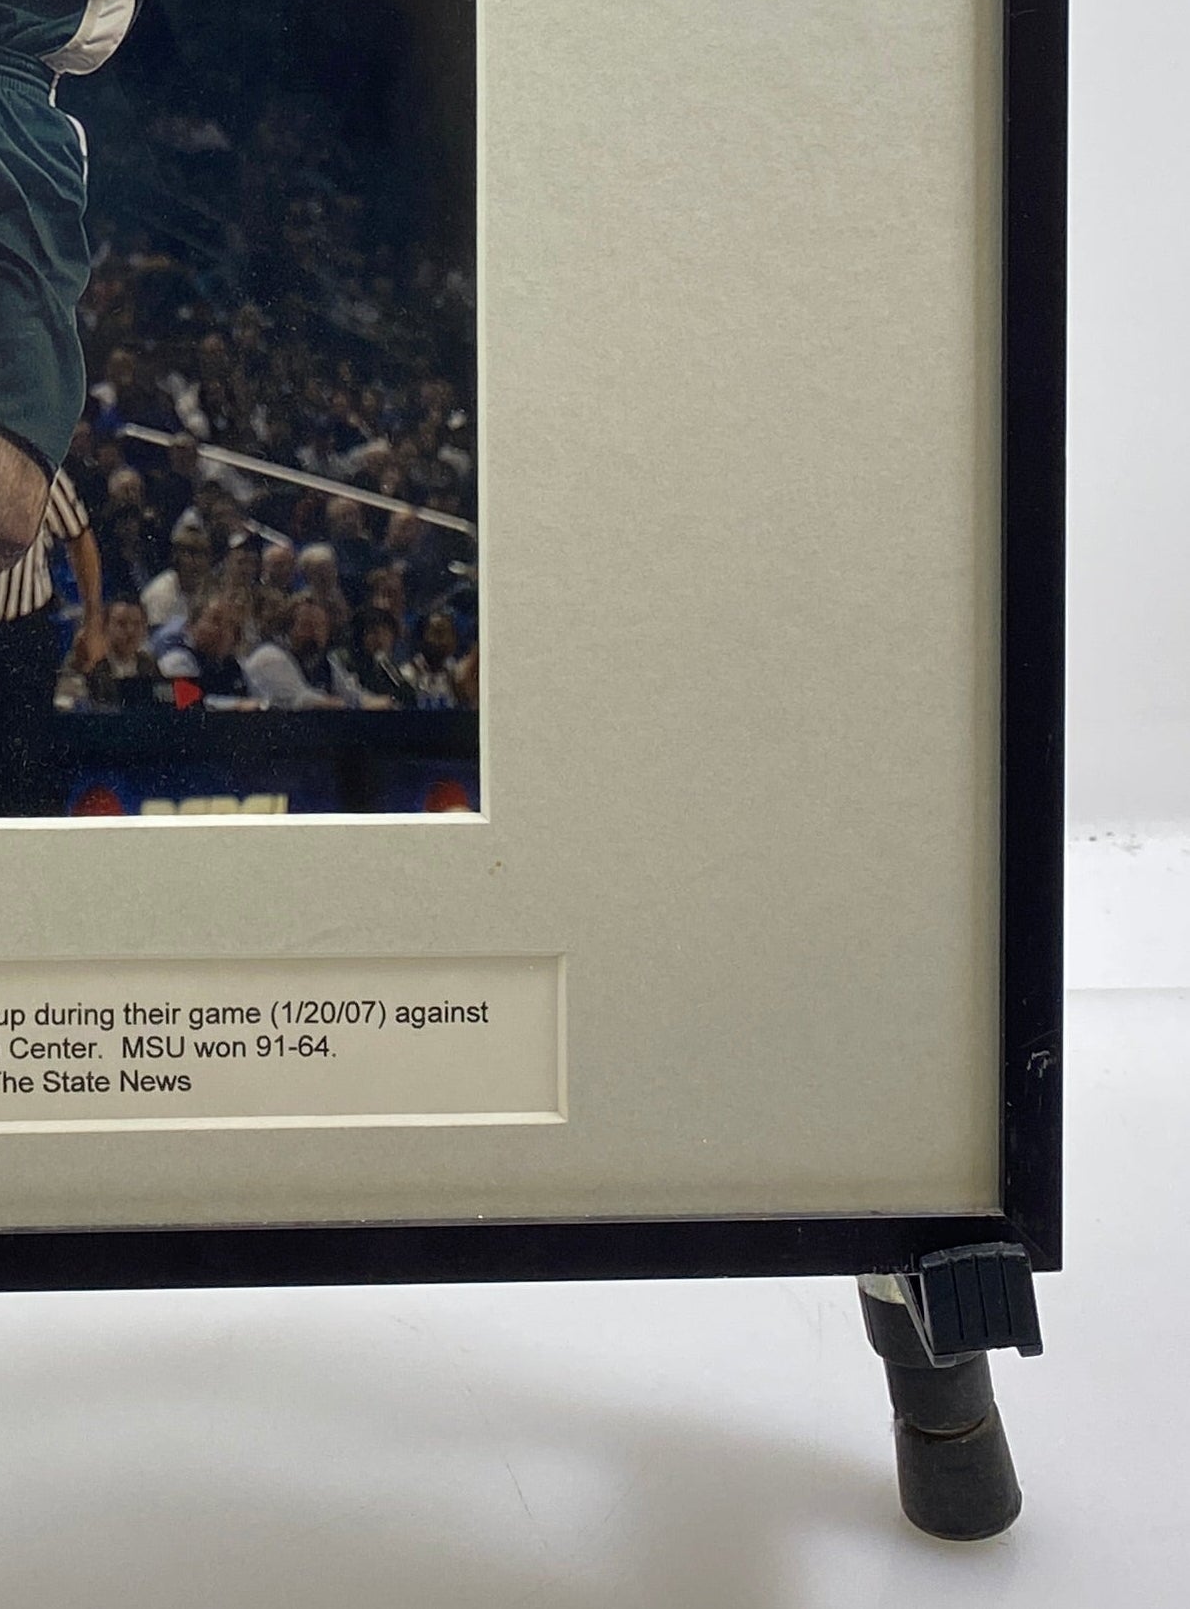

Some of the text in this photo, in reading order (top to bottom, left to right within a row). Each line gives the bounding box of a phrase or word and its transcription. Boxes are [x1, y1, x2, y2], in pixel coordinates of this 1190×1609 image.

[34, 1001, 115, 1032] during
[122, 1001, 182, 1026] their
[188, 1006, 262, 1031] game
[270, 999, 387, 1030] (1/20/07)
[395, 999, 489, 1030] against
[9, 1036, 103, 1060] Center.
[122, 1035, 185, 1059] MSU
[193, 1040, 247, 1059] won
[255, 1034, 337, 1058] 91-64.
[42, 1069, 111, 1094] State
[119, 1069, 193, 1093] News
